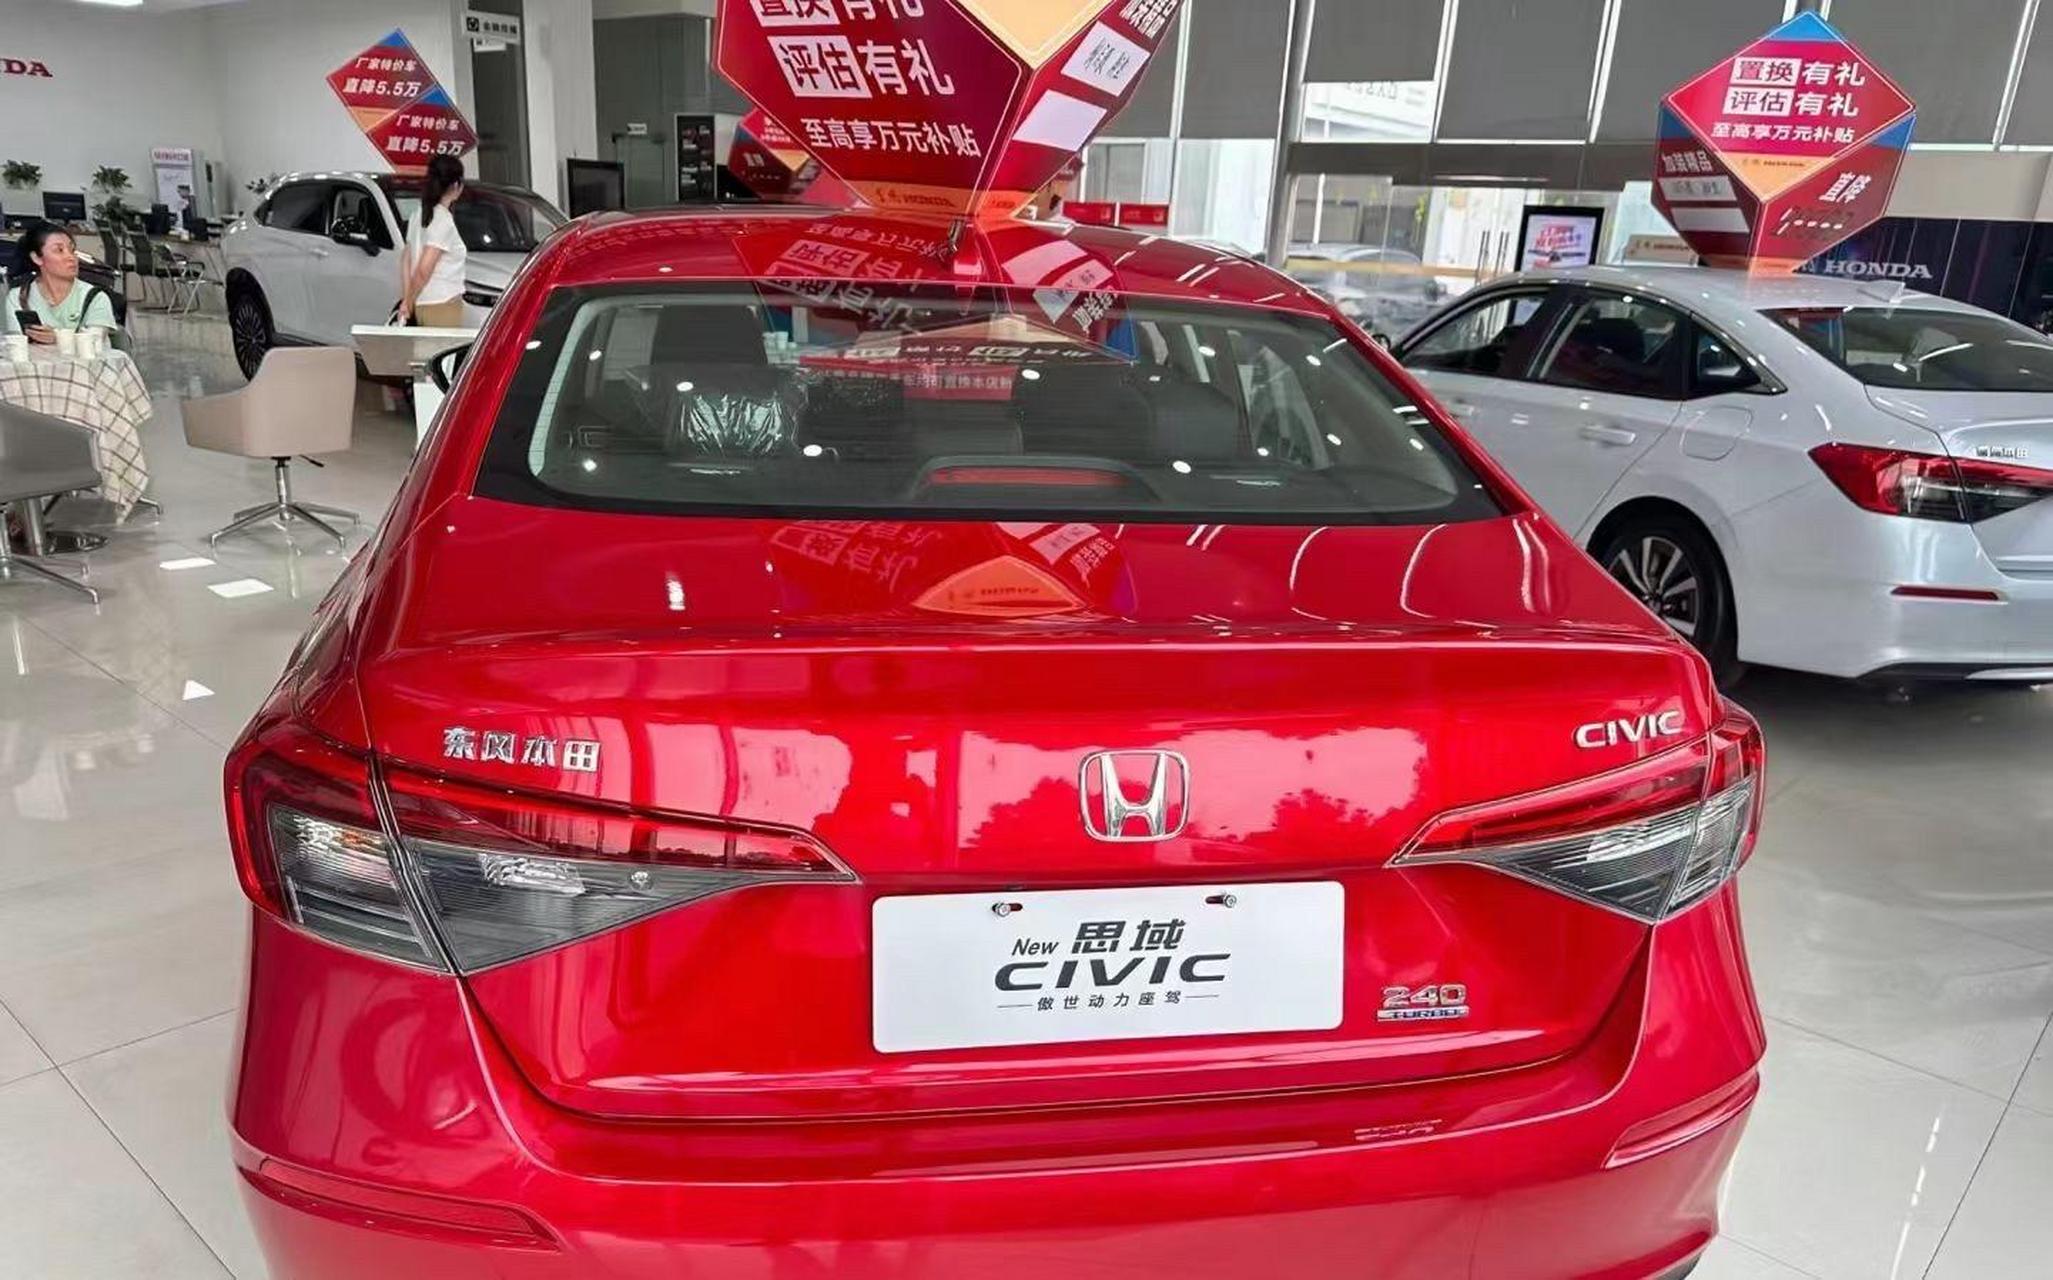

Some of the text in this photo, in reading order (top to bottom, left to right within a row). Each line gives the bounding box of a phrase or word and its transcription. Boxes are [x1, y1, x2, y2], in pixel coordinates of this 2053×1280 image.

[355, 57, 417, 73] 厂家特价车
[779, 37, 956, 96] 评估有礼
[1735, 59, 1866, 87] 置换有礼
[343, 77, 421, 98] 直降5.5万
[1730, 91, 1860, 118] 评估有礼
[396, 114, 460, 132] 厂家特价车
[1710, 121, 1856, 144] 至高享万元补贴
[385, 135, 466, 156] 直降5.5万
[801, 117, 982, 158] 至高享万元补贴
[1824, 259, 1933, 280] HONDA
[1574, 710, 1682, 749] CIVIC
[443, 725, 602, 773] 东风本田
[1011, 918, 1186, 956] New 思域
[994, 953, 1231, 991] CIVIC
[1037, 990, 1182, 1012] 傲世动力座驾
[1382, 984, 1467, 1009] 240
